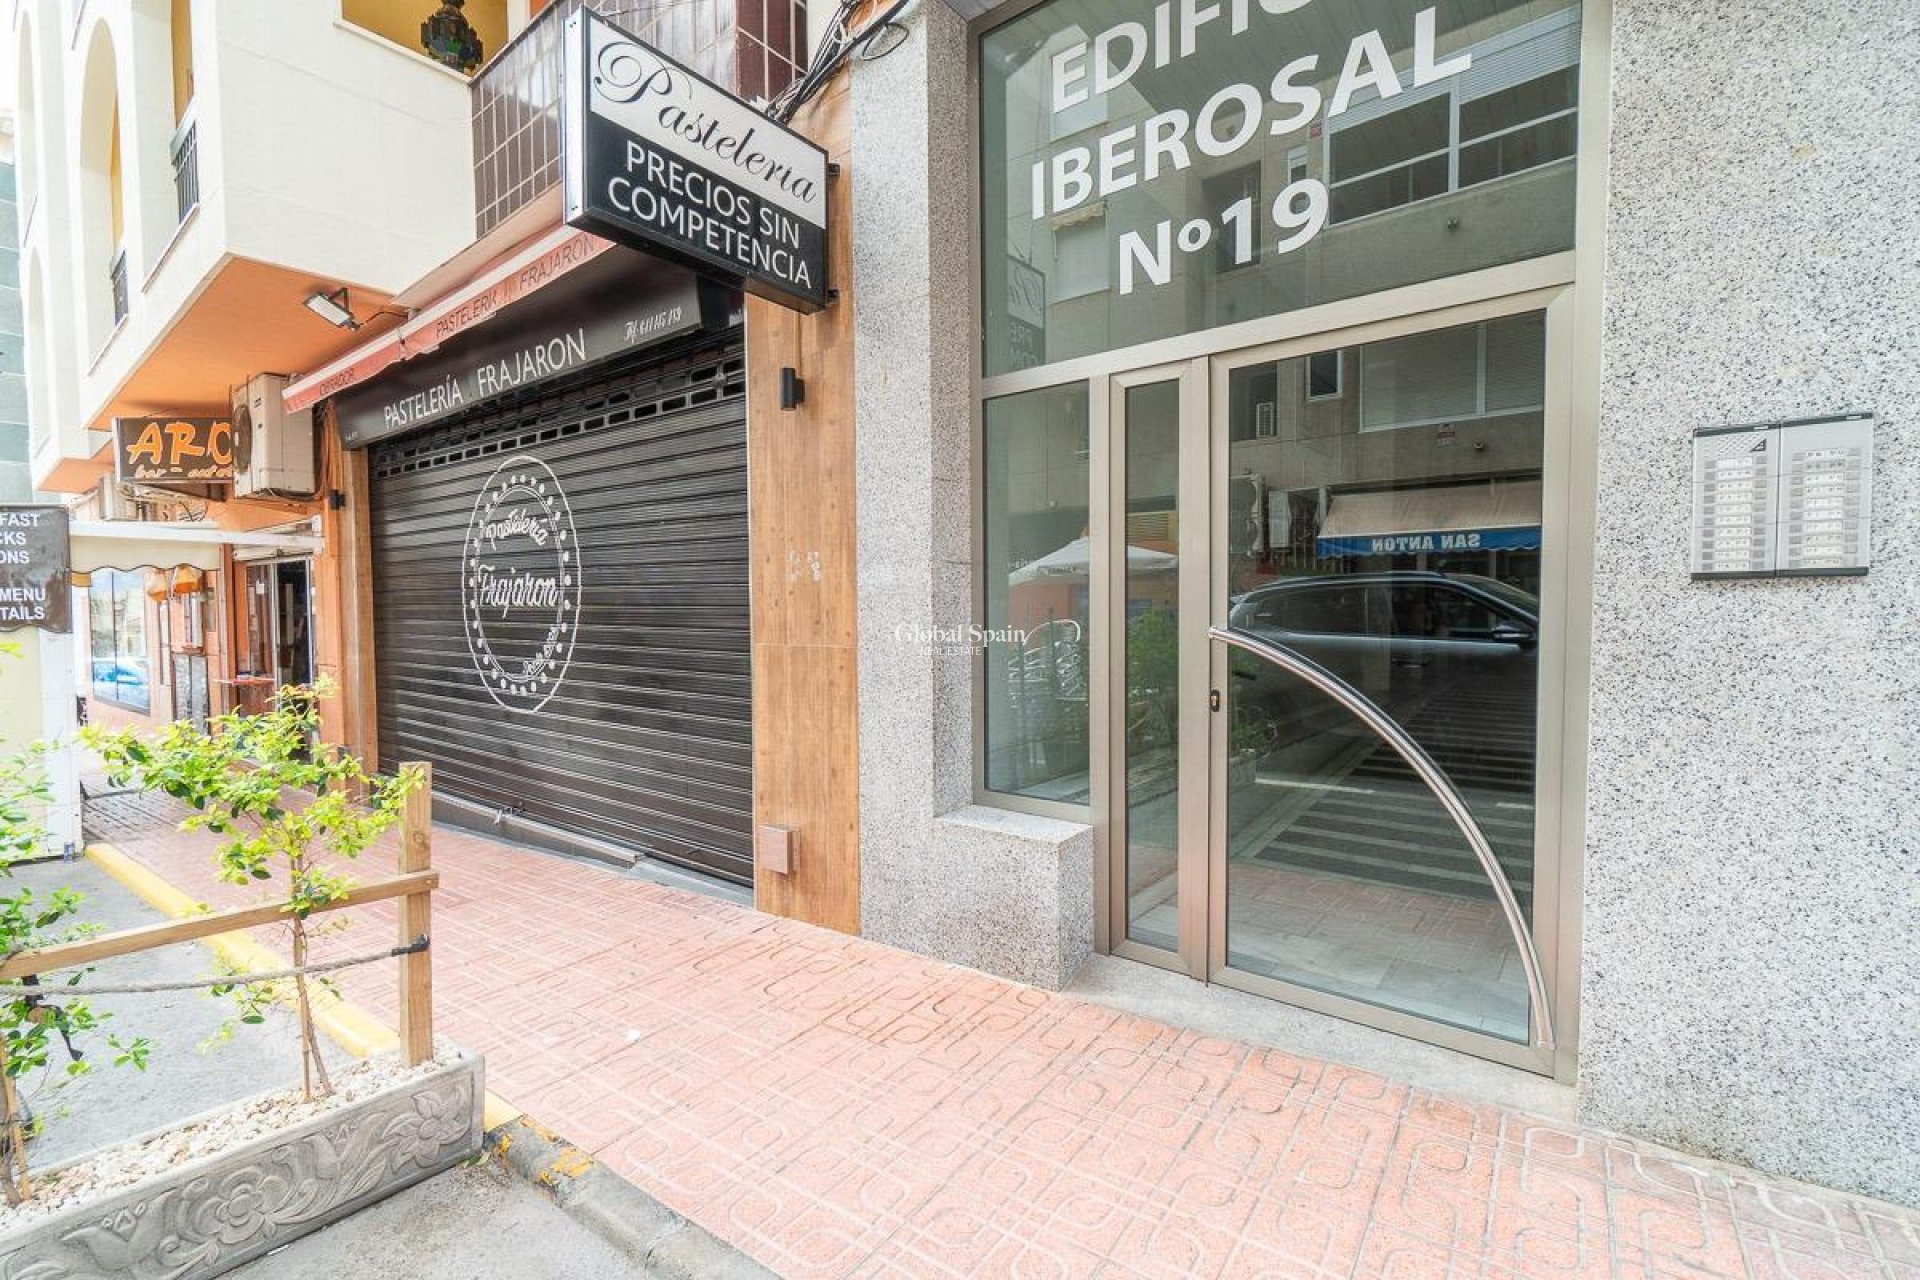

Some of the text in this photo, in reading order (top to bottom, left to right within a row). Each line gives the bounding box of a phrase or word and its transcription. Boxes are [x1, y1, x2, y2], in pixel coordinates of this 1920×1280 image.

[1052, 0, 1312, 113] EDIFI
[1032, 7, 1472, 220] IBEROSAL
[608, 177, 812, 289] COMPETENCIA
[626, 140, 799, 250] PRECIOS SIN
[519, 235, 595, 292] FRAJARON
[383, 327, 587, 431] PASTELERÍA FRAJARON
[0, 588, 45, 602] MENU
